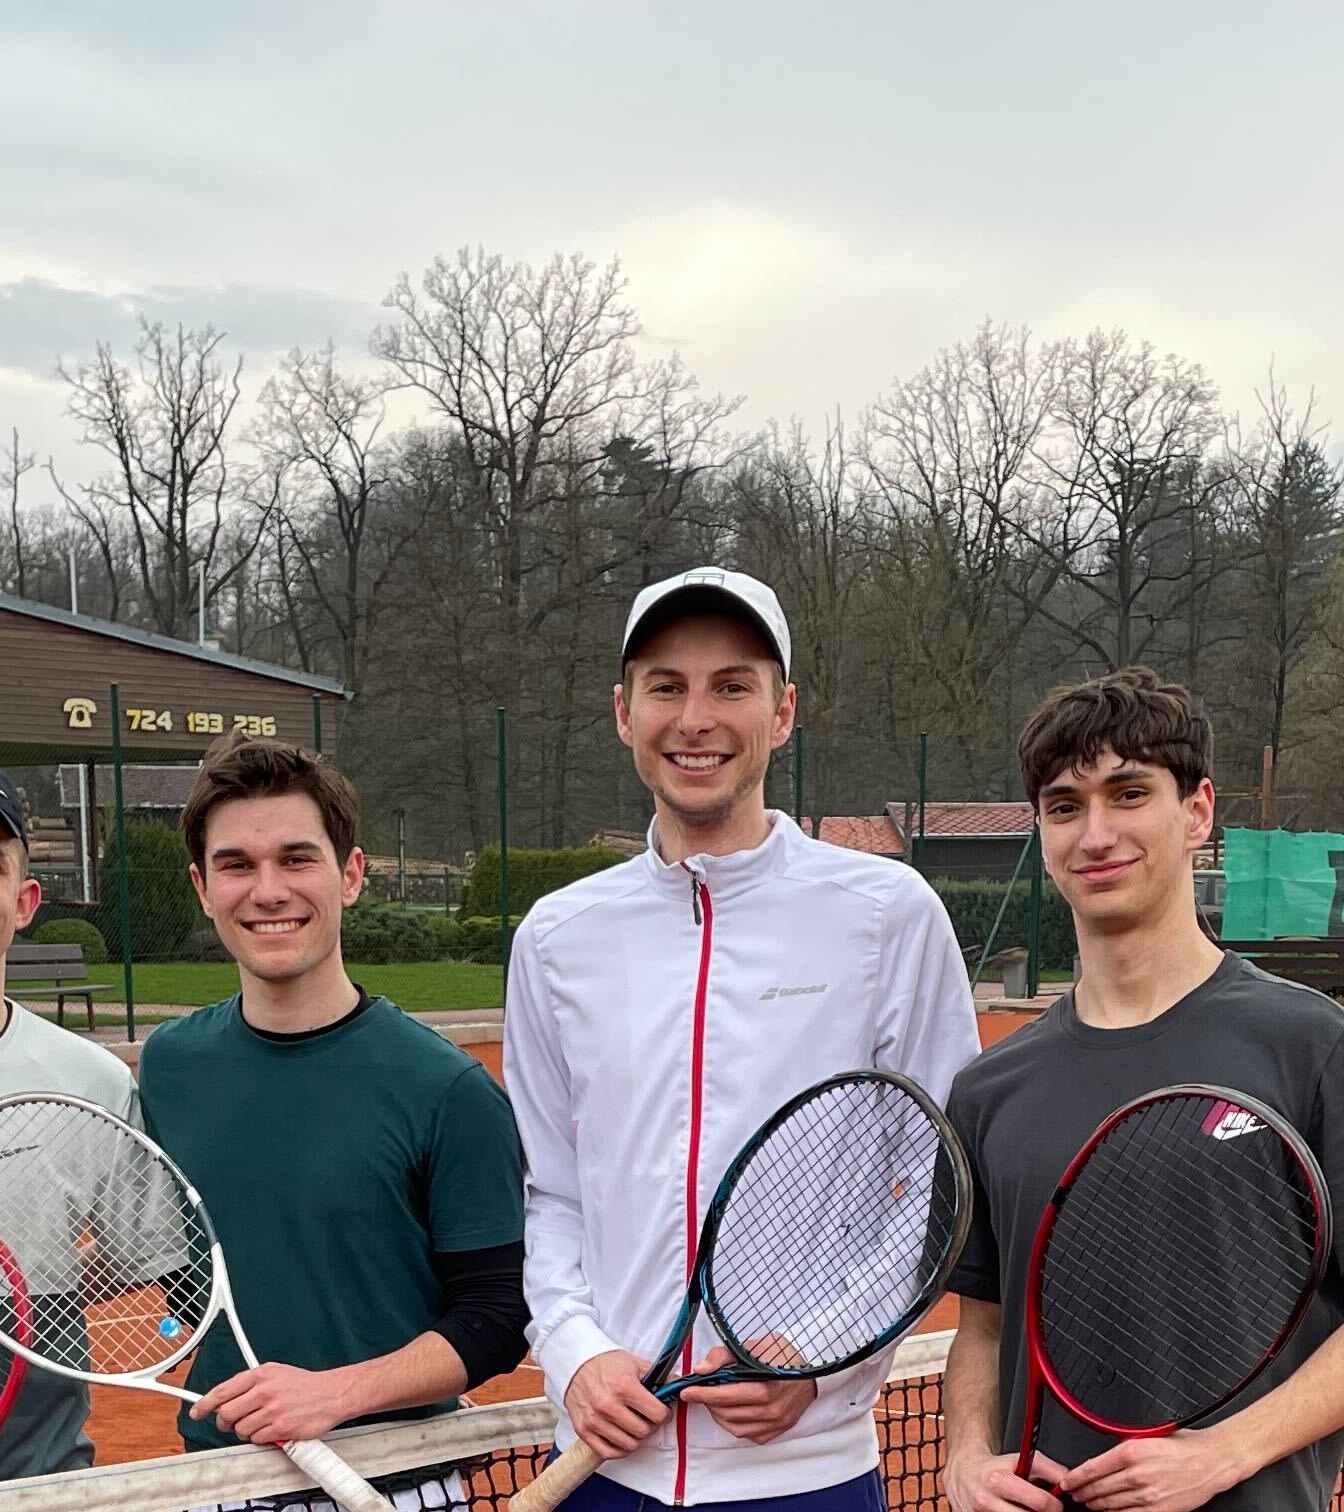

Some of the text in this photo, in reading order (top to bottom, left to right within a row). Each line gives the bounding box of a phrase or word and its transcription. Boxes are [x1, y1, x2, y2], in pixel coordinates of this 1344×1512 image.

[126, 708, 277, 738] 724 193 236
